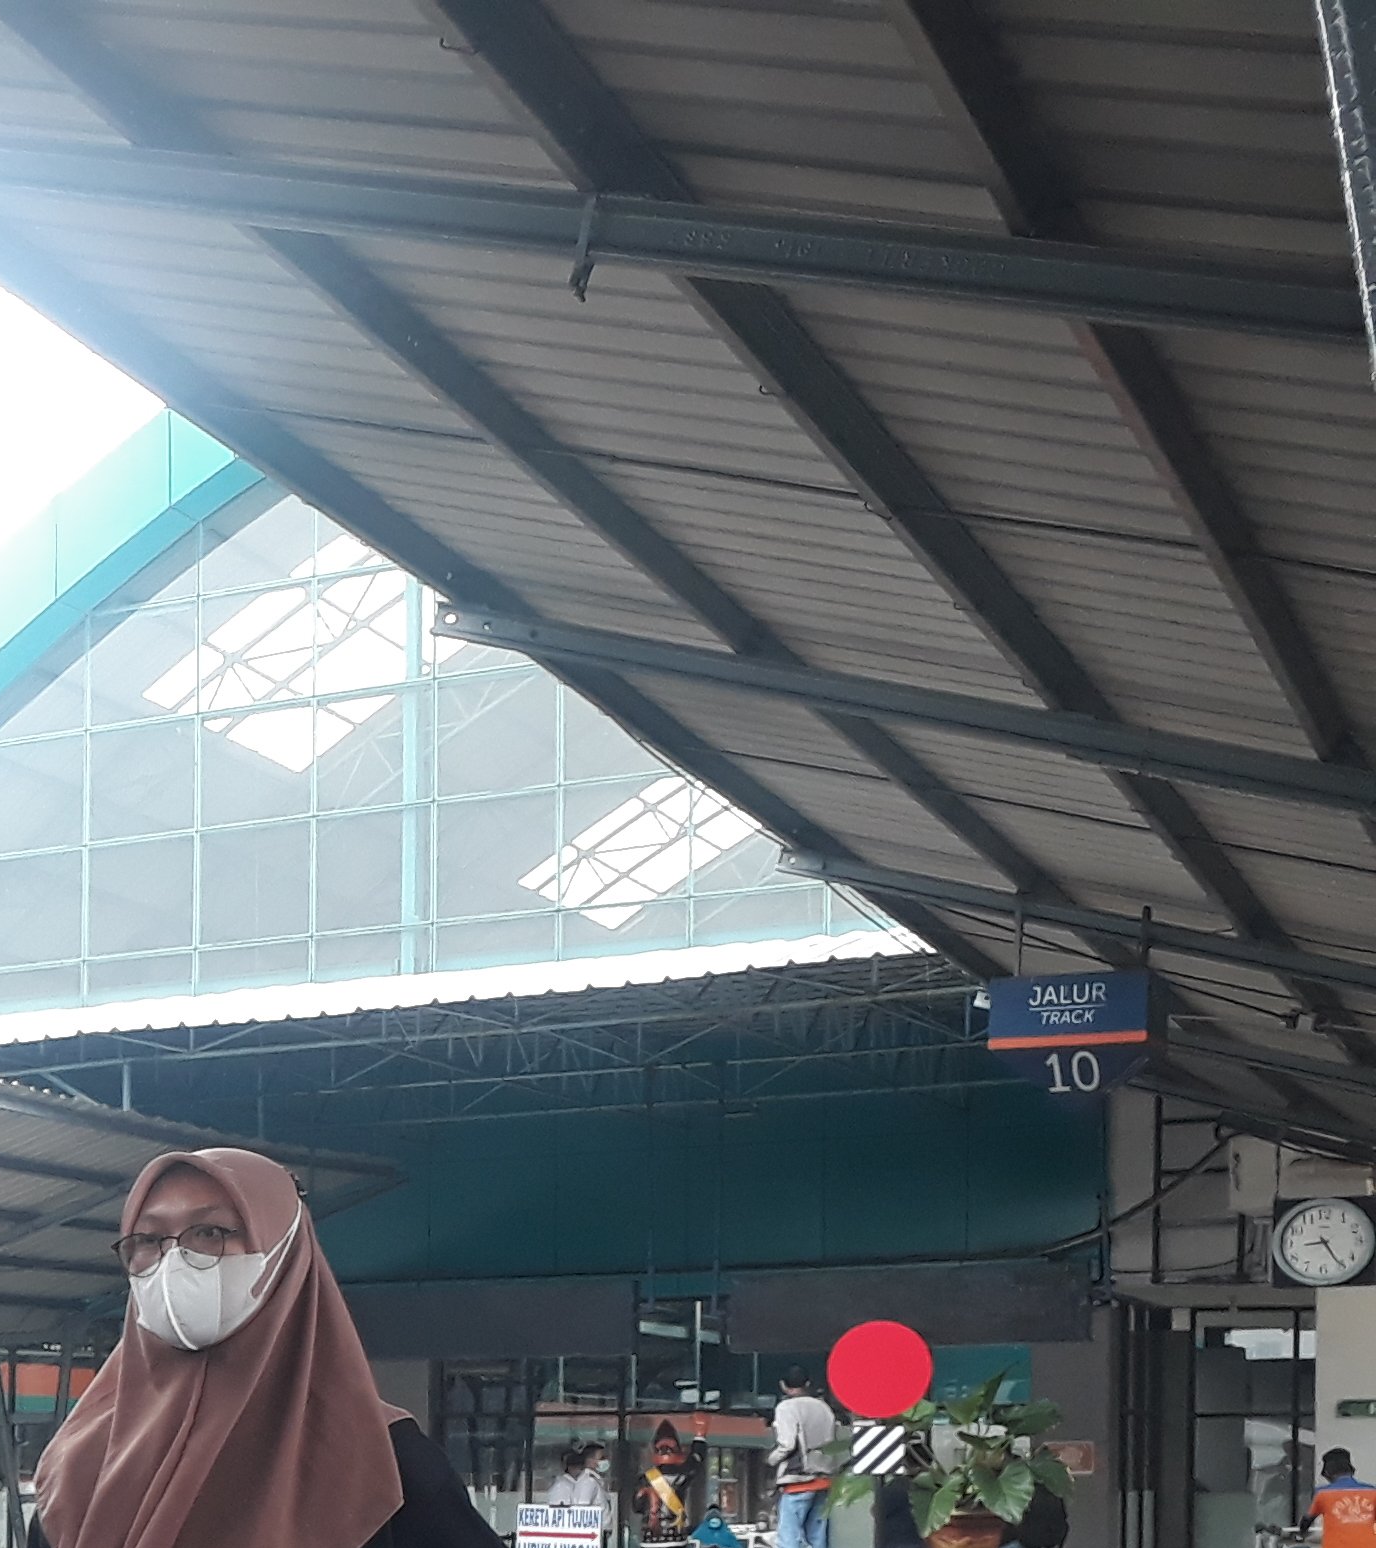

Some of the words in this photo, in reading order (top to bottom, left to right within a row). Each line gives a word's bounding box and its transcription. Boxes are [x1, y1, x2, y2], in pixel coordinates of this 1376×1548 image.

[1028, 982, 1107, 1006] JALUR
[1040, 1009, 1096, 1025] TRACK
[1044, 1050, 1101, 1093] 10
[519, 1507, 550, 1527] KERETA
[551, 1508, 565, 1527] API
[567, 1508, 600, 1529] TUJUAN
